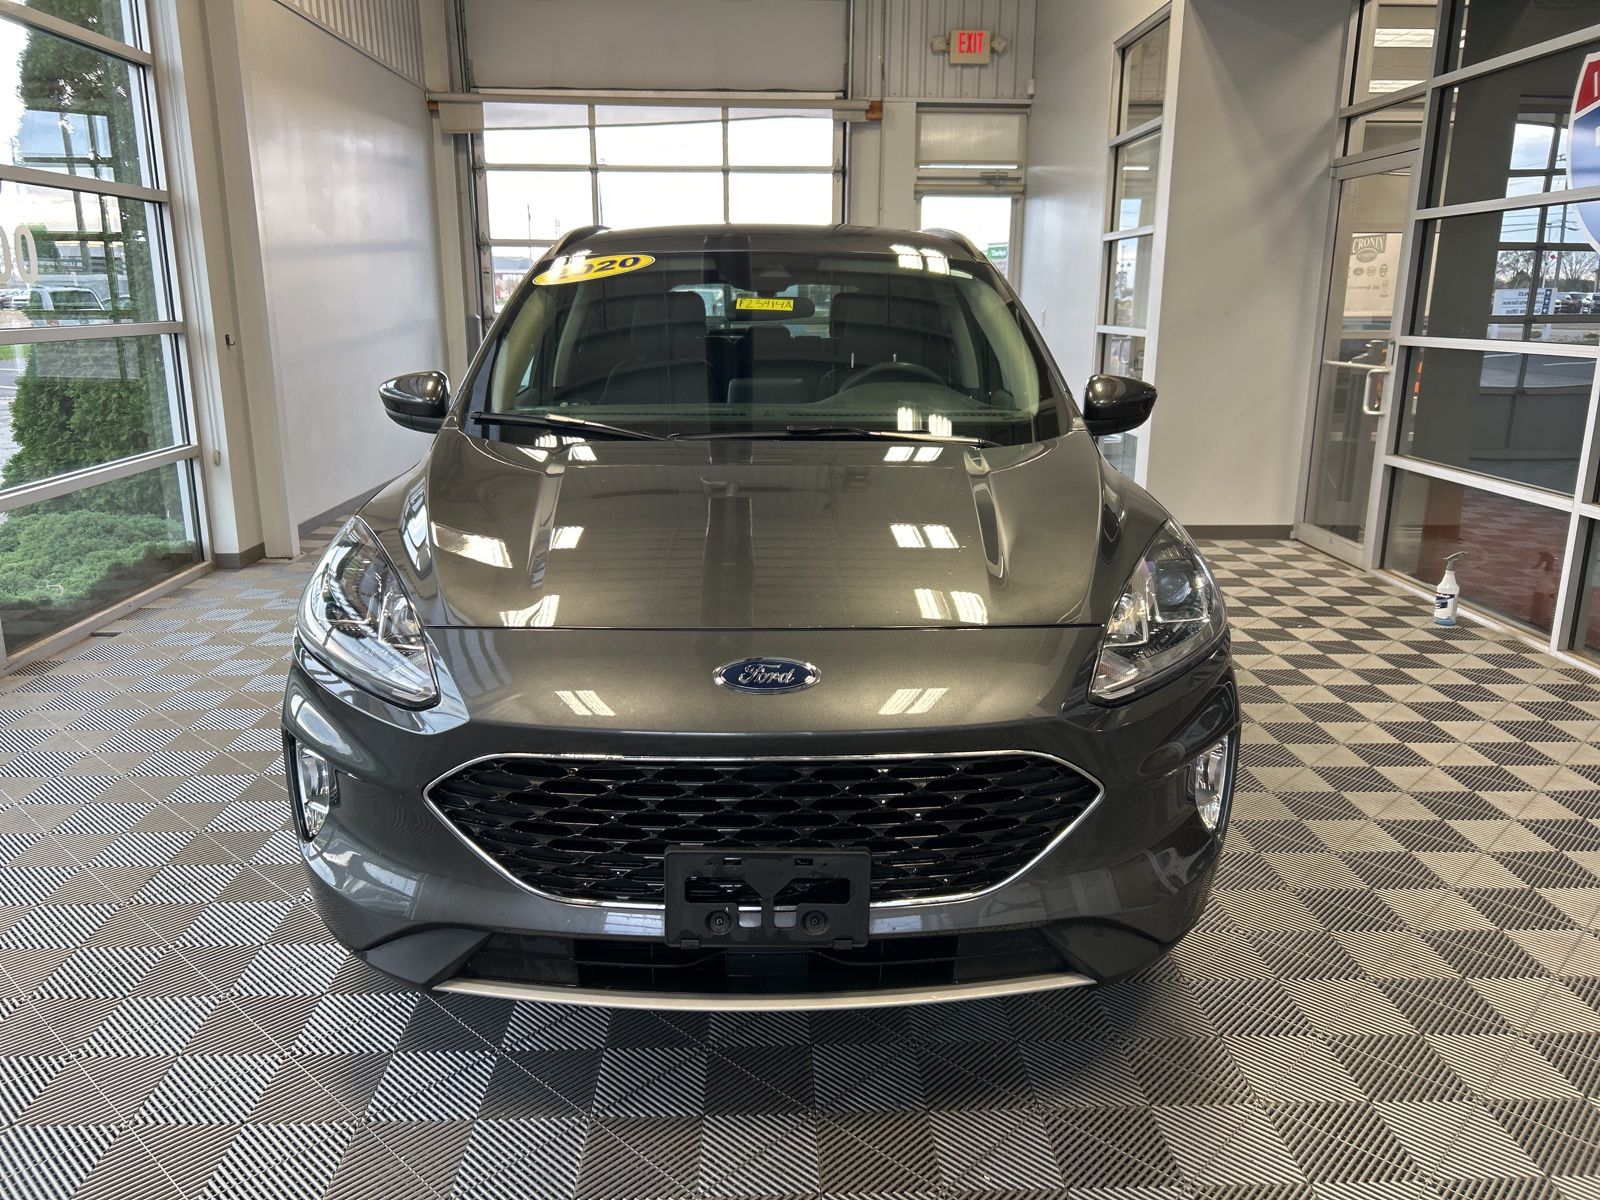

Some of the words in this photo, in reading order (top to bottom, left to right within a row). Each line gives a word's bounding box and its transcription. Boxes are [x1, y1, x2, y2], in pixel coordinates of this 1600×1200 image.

[958, 32, 985, 54] EXIT
[1352, 235, 1387, 254] CRONIN
[558, 256, 642, 280] 020
[738, 663, 796, 684] Ford
